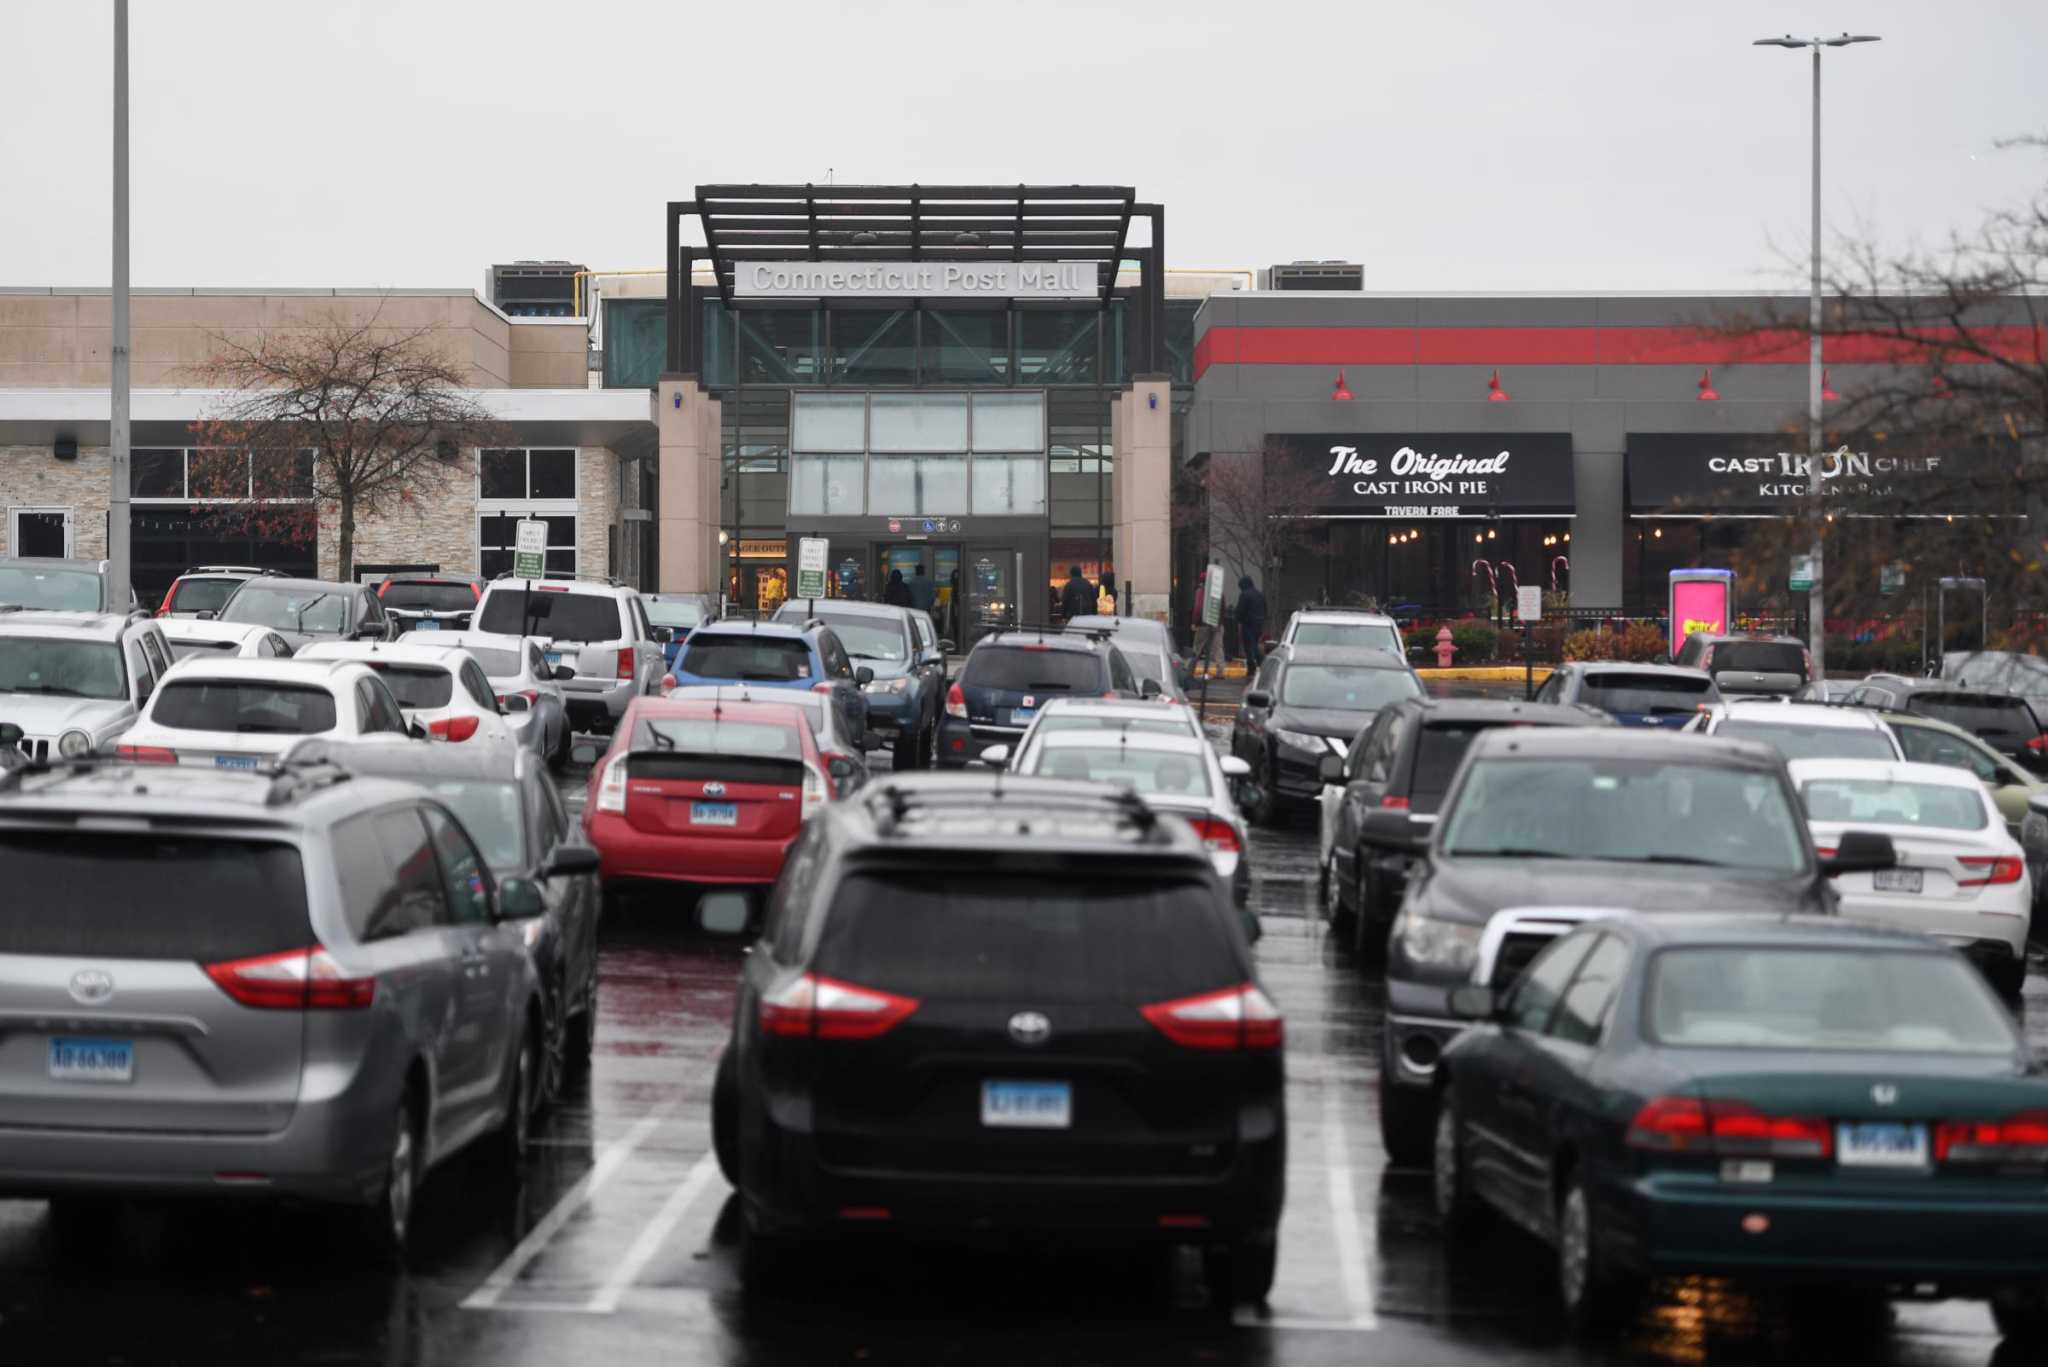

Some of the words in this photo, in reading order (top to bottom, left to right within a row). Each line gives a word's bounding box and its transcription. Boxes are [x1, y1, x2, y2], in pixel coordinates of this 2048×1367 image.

[752, 264, 933, 291] Connecticut
[944, 265, 1006, 291] Post
[1017, 263, 1080, 291] Mall
[1327, 446, 1378, 476] The
[1390, 447, 1510, 481] Original
[1708, 457, 1774, 473] CAST
[1353, 480, 1399, 495] CAST
[1404, 480, 1453, 495] IRON
[1460, 480, 1487, 494] PIE
[1384, 506, 1428, 516] TAVERN
[1430, 506, 1459, 516] FARE
